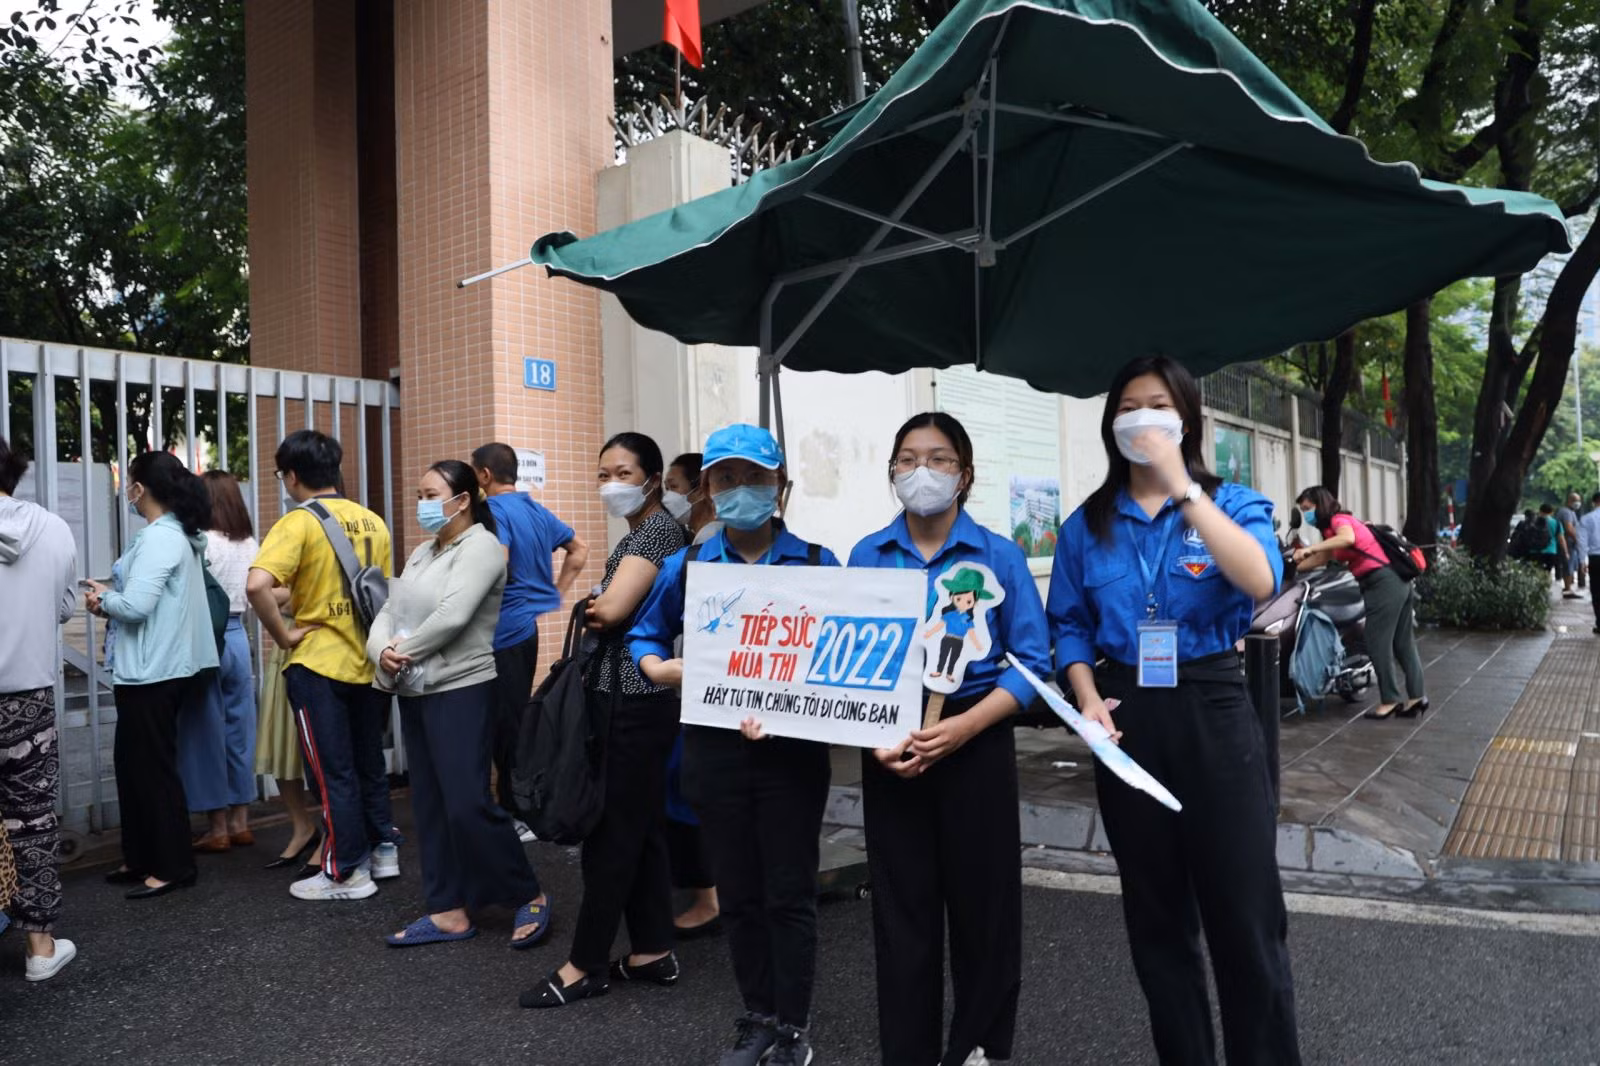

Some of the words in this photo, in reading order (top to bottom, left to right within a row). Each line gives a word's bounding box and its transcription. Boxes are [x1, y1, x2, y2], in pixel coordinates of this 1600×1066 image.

[530, 361, 551, 386] 18
[740, 602, 777, 647] TIẾP
[778, 604, 816, 649] SỨC
[727, 648, 762, 680] MÙA
[768, 653, 798, 683] THI
[807, 620, 904, 687] 2022
[703, 683, 729, 706] HÃY
[730, 688, 746, 711] TỰ
[765, 689, 801, 715] CHÚNG
[802, 692, 819, 717] TÔI
[819, 698, 835, 719] ĐI
[834, 694, 867, 723] CÙNG
[868, 703, 900, 730] BẠN
